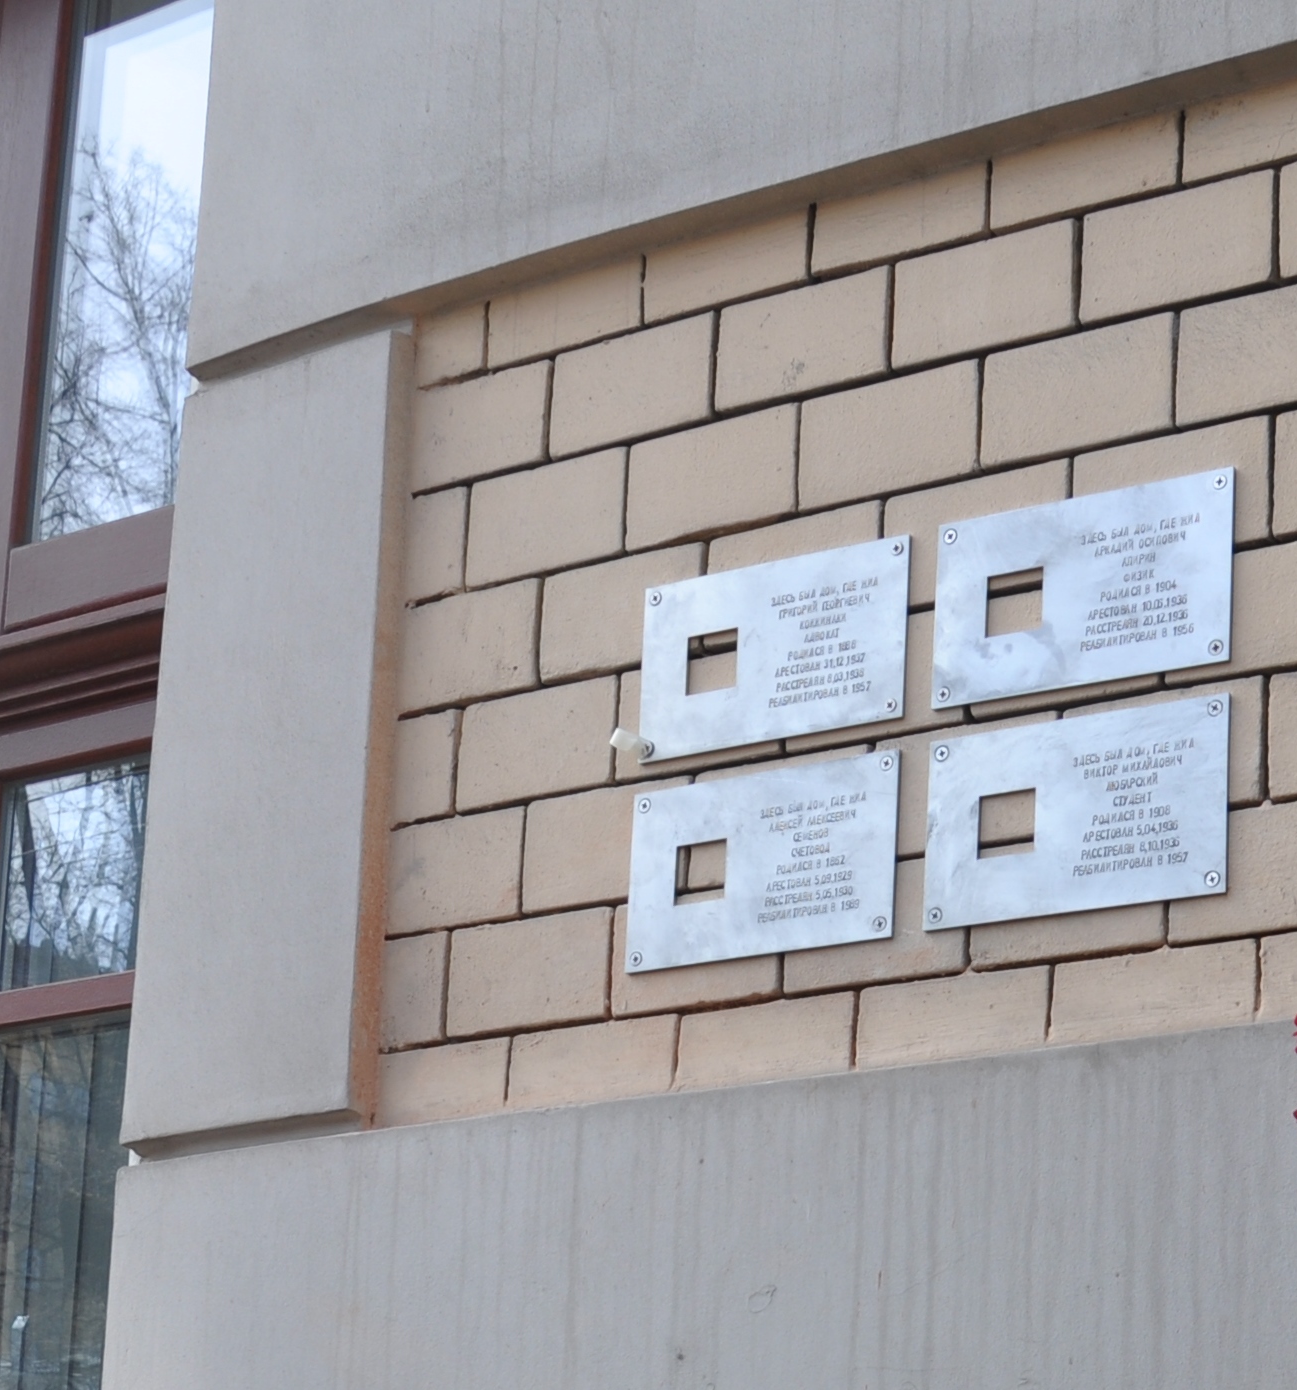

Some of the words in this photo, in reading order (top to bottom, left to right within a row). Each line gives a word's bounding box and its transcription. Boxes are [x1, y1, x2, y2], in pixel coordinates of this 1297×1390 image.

[1081, 532, 1107, 545] ЗДЕСЬ
[1111, 526, 1129, 539] БЫЛ
[1160, 518, 1176, 531] ГДЕ
[1095, 538, 1134, 557] АРКАДИЙ
[1139, 531, 1186, 549] ОСИПОВИЧ
[1124, 569, 1155, 582] ФИЗИК
[771, 594, 795, 607] ЗДЕСЬ
[799, 589, 816, 601] БЫЛ
[842, 581, 856, 592] ГДЕ
[1100, 585, 1141, 602] РОДИЛСЯ
[1155, 580, 1176, 592] 1904
[779, 601, 818, 619] ГРИГОРИЙ
[822, 593, 870, 611] ГЕОРГИЕВИЧ
[1088, 604, 1137, 621] АРЕСТОВАН
[804, 628, 839, 643] АДВОКАТ
[1085, 618, 1138, 636] РАССТРЕЛЯН
[1080, 630, 1157, 652] РЕАБИЛИТИРОВАН
[788, 646, 824, 661] РОДИЛСЯ
[775, 662, 821, 678] АРЕСТОВАН
[776, 675, 824, 692] РАССТРЕЛЯН
[769, 687, 839, 708] РЕАБИЛИТИРОВАН
[1073, 753, 1100, 768] ЗДЕСЬ
[1104, 749, 1123, 761] БЫЛ
[1153, 742, 1169, 754] ГДЕ
[1084, 764, 1118, 779] ВИКТОР
[1122, 755, 1182, 773] МИХАЙЛОВИЧ
[1106, 772, 1158, 792] ЛЮБАРСКИЙ
[760, 806, 784, 819] ЗДЕСЬ
[788, 800, 804, 813] БЫЛ
[831, 795, 845, 806] ГДЕ
[1113, 792, 1152, 807] СТУДЕНТ
[769, 815, 802, 832] АЛЕКСЕЙ
[807, 809, 856, 826] АЛЕКСЕЕВИЧ
[1092, 810, 1135, 826] РОДИЛСЯ
[1150, 805, 1170, 818] 1908
[1083, 826, 1133, 842] АРЕСТОВАН
[791, 843, 830, 857] СЧЕТОВОД
[1081, 843, 1135, 860] РАССТРЕЛЯН
[776, 861, 812, 875] РОДИЛСЯ
[1073, 857, 1152, 876] РЕАБИЛИТИРОВАН
[766, 877, 811, 892] АРЕСТОВАН
[765, 892, 812, 907] РАССТРЕЛЯН
[758, 904, 828, 923] РЕАБИЛИТИРОВАН
